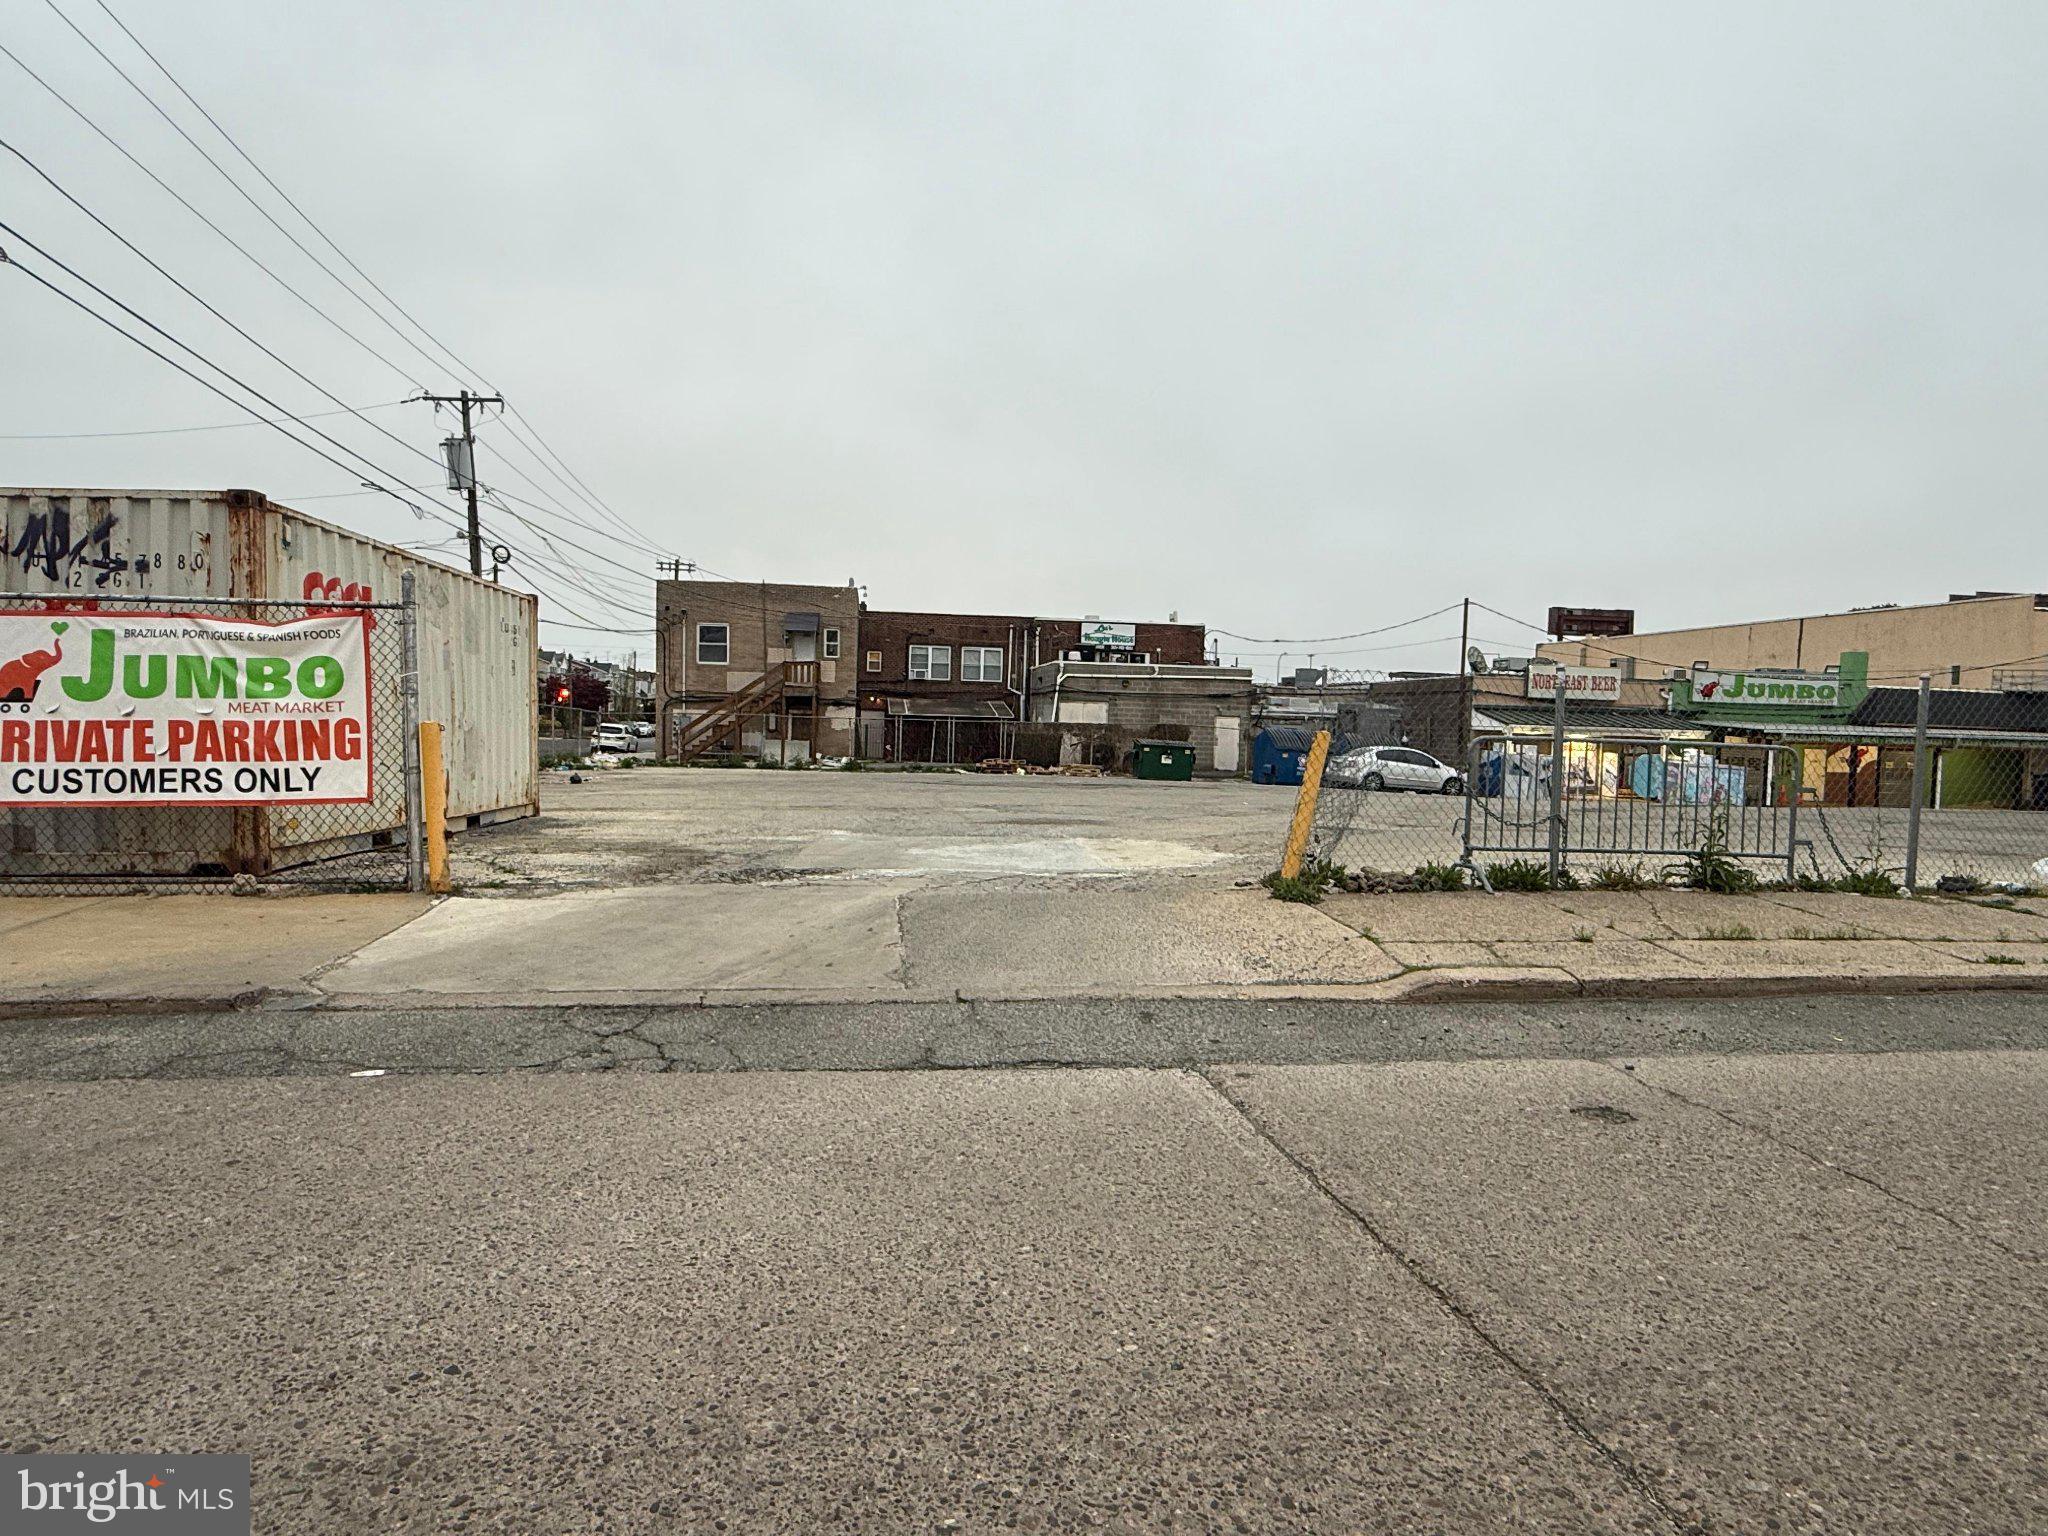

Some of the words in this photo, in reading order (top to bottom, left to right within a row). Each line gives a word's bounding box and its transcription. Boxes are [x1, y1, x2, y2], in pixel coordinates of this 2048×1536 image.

[123, 628, 179, 639] BRAZILIAN,
[246, 632, 255, 642] &
[256, 632, 302, 642] SPANISH
[303, 629, 341, 641] FOODS
[61, 629, 345, 701] JUMBO
[1532, 673, 1588, 690] NORTEAST
[1591, 675, 1617, 691] BEER
[1722, 675, 1836, 699] JUMBO
[228, 702, 271, 714] MEAT
[274, 700, 346, 714] MARKET
[166, 718, 361, 762] PARKING
[12, 768, 224, 794] CUSTOMERS
[234, 766, 322, 792] ONLY
